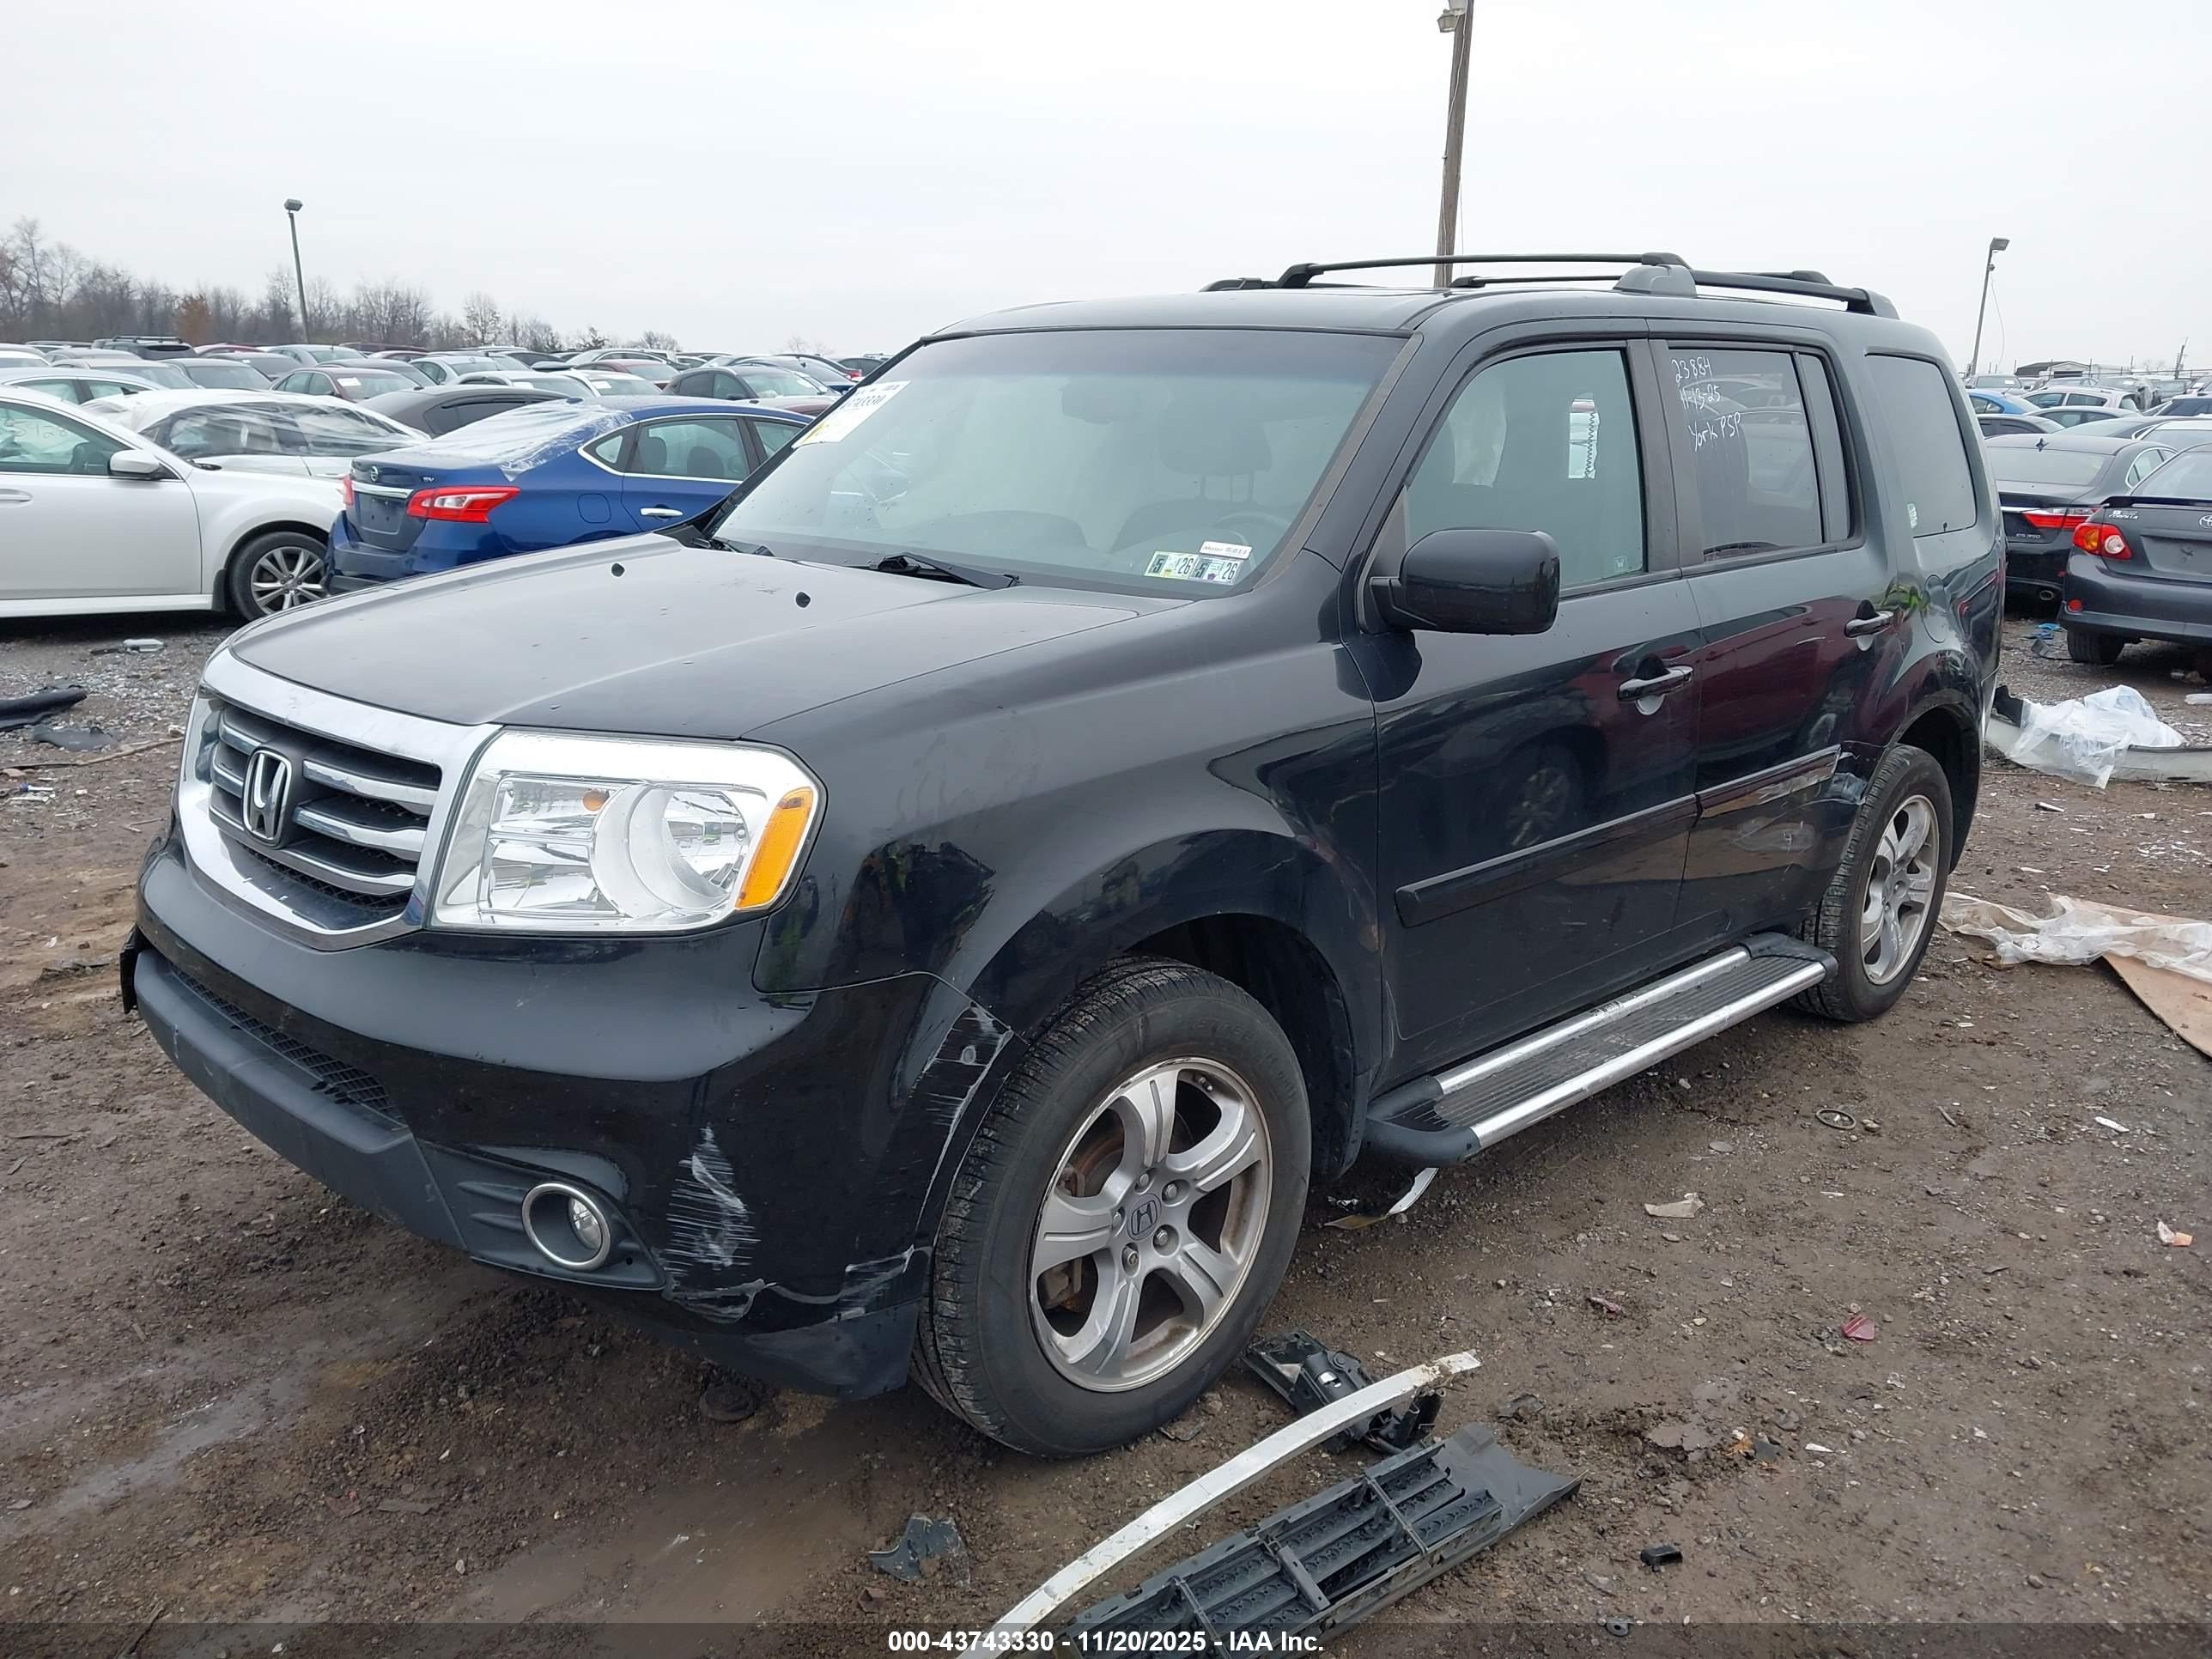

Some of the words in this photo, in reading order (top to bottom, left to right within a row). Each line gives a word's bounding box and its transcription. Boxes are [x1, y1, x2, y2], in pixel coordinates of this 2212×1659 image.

[1671, 356, 1712, 383] 23884
[1680, 384, 1721, 410] 11-13-25
[1687, 421, 1718, 452] York
[1720, 411, 1741, 439] PSP
[1152, 558, 1164, 574] 5
[1177, 557, 1194, 574] 26
[1222, 562, 1238, 580] 26
